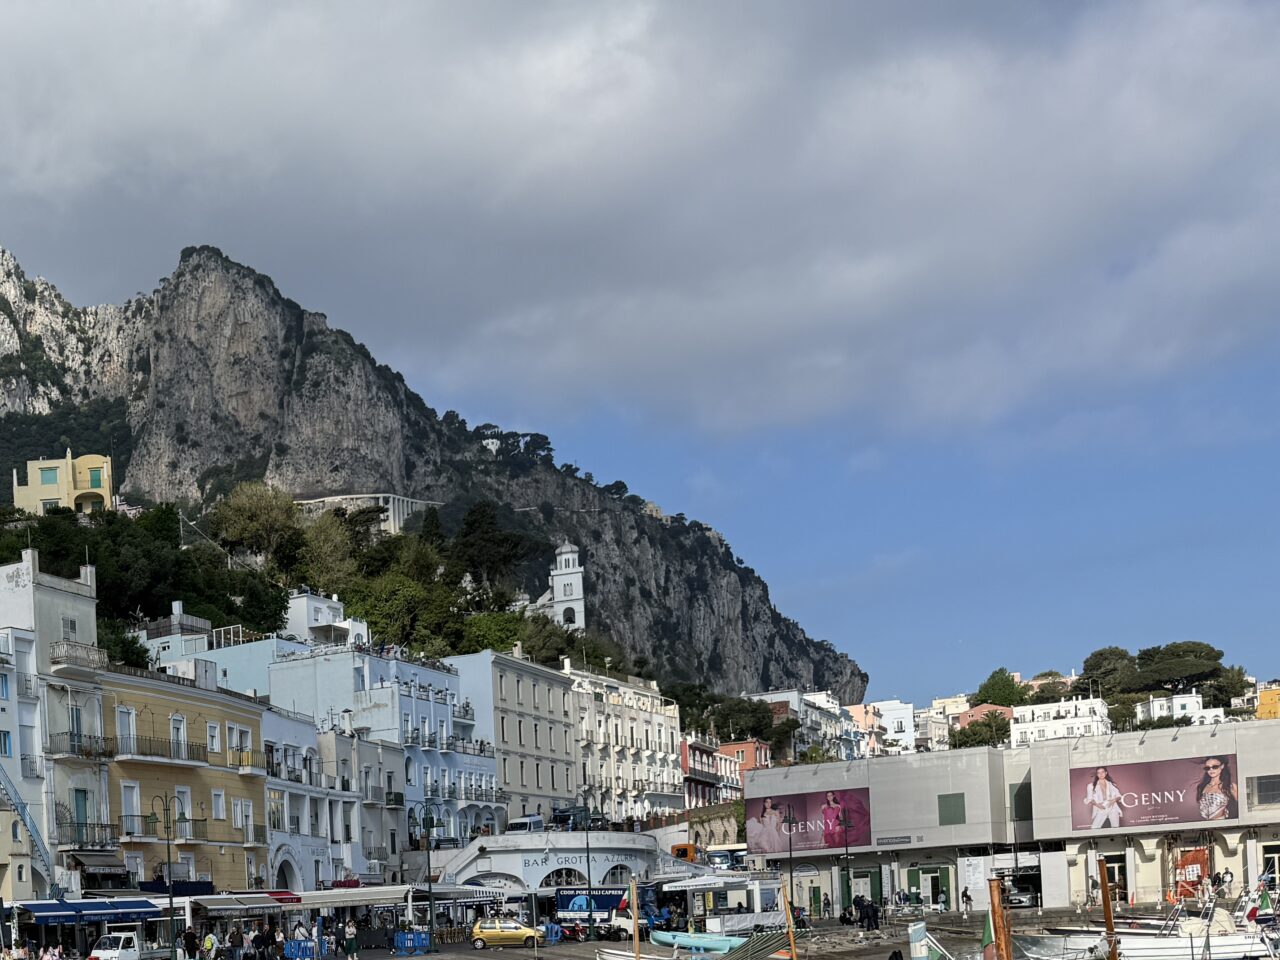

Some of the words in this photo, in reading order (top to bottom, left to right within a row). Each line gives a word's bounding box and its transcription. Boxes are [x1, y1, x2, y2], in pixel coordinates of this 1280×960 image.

[1121, 789, 1186, 808] GENNY
[781, 818, 835, 835] GENNY
[523, 858, 548, 868] BAR
